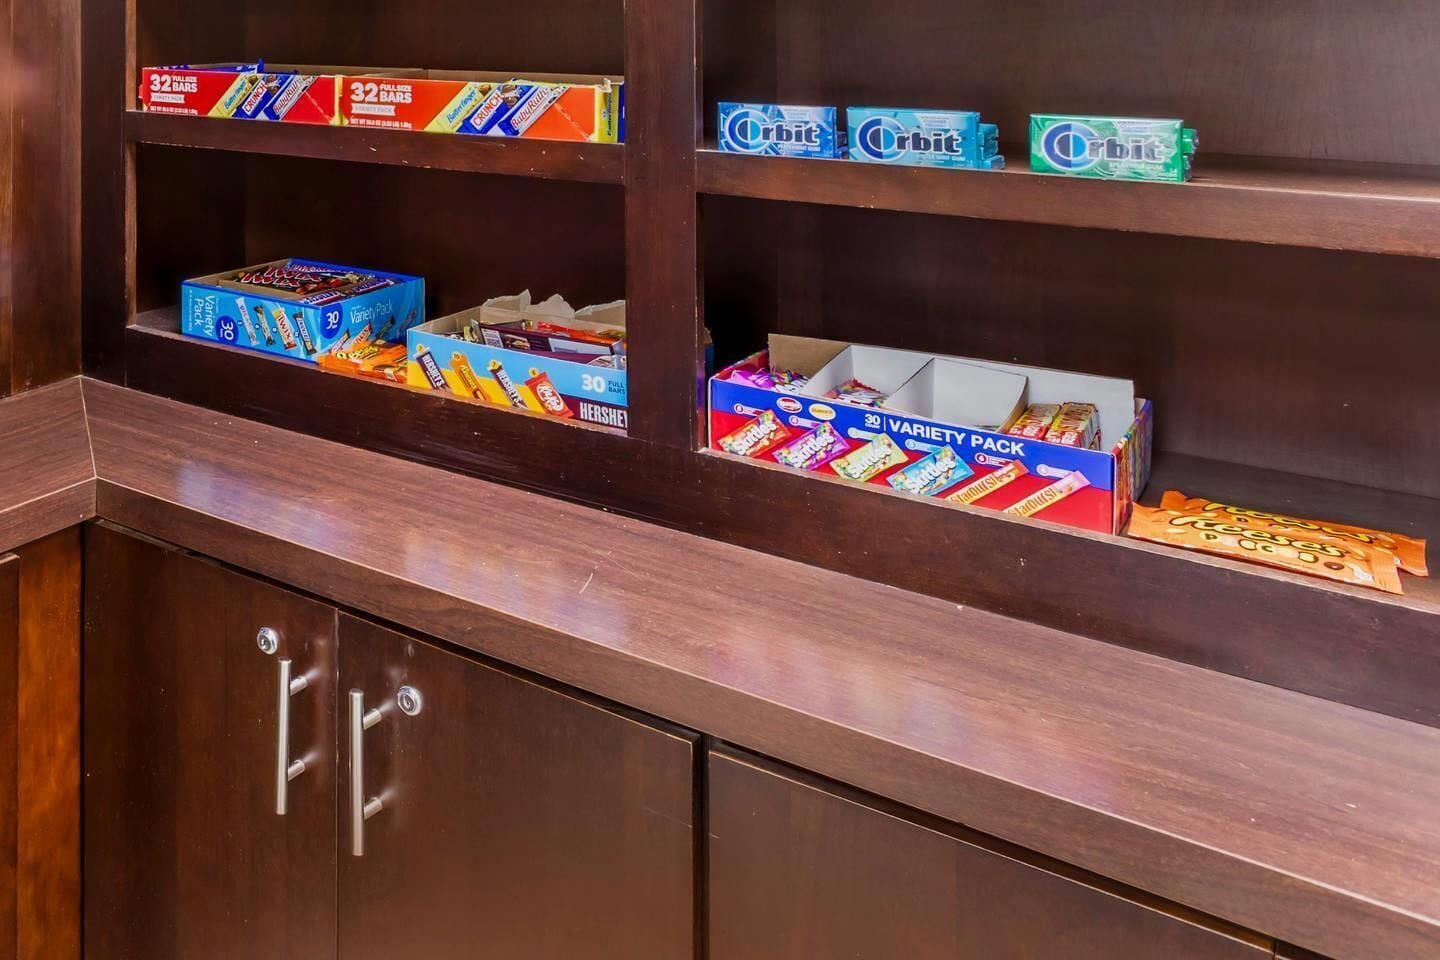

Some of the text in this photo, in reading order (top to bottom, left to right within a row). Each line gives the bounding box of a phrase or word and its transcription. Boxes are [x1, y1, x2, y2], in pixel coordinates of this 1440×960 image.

[150, 73, 172, 92] 32
[172, 82, 198, 93] BARS
[350, 82, 379, 102] 32
[243, 81, 268, 113] CRUNCH
[380, 91, 413, 104] BARS
[472, 92, 504, 127] CRUNCH
[725, 107, 820, 152] Orbit
[857, 115, 962, 162] Orbit
[1041, 121, 1166, 171] Orbit
[193, 298, 205, 326] Pack
[204, 295, 216, 337] Variety
[326, 311, 339, 330] 30
[350, 298, 394, 324] Variety Pack
[221, 320, 234, 341] 30
[277, 312, 292, 340] TWIX
[581, 373, 606, 393] 30
[608, 380, 624, 389] FULL
[608, 387, 625, 395] BARS
[864, 413, 881, 425] 30
[733, 420, 778, 457] Skittles
[789, 431, 836, 469] Skittles
[889, 417, 1026, 457] VARIETY PACK
[904, 455, 958, 493] Skittles
[1170, 515, 1351, 558] Reese's
